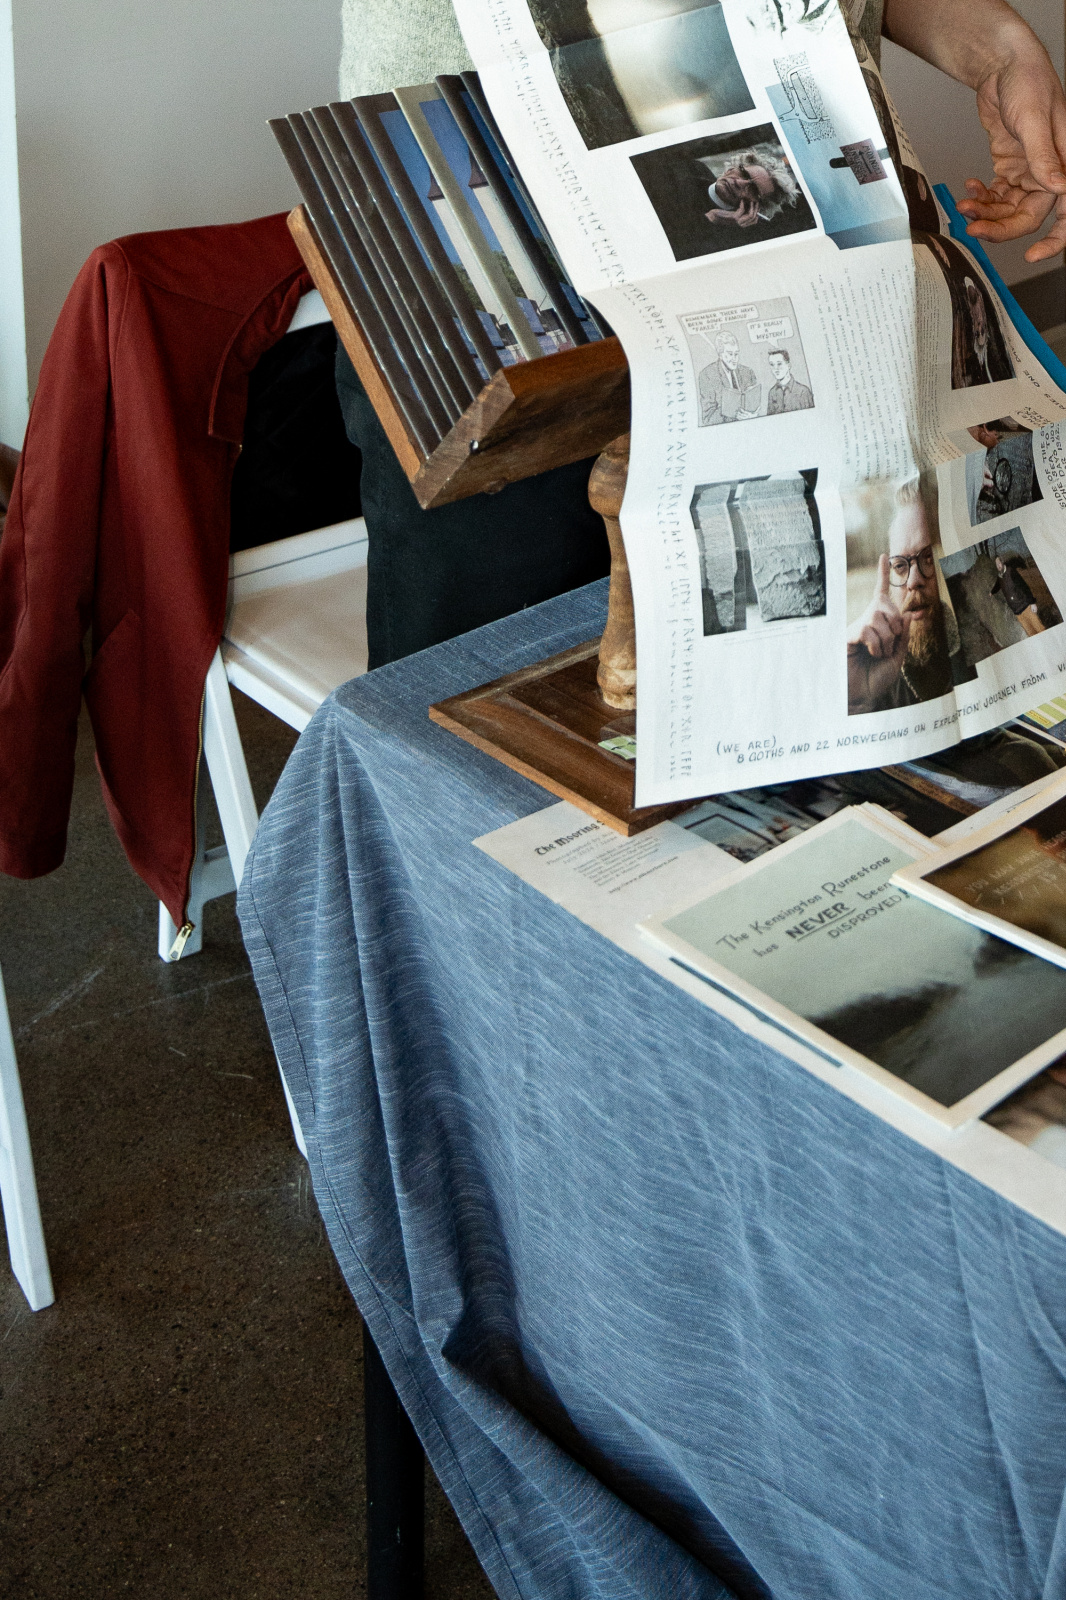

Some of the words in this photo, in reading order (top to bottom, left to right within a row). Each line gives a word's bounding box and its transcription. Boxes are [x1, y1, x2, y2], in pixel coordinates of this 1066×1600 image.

[720, 310, 737, 318] THERE
[724, 313, 747, 322] FAMOUS
[756, 329, 786, 340] MYSTERY!
[1022, 369, 1040, 388] ONE
[1044, 469, 1053, 481] OF
[1052, 486, 1066, 508] SIDE
[737, 754, 744, 763] 8
[749, 747, 785, 762] GOTHS
[790, 743, 810, 754] AND
[816, 740, 830, 750] 22
[836, 728, 909, 747] NORWEGIANS
[914, 723, 926, 733] ON
[983, 684, 1017, 708] JOURNEY
[716, 741, 740, 755] (WE
[747, 735, 777, 749] ARE)
[534, 843, 555, 856] The
[554, 822, 600, 847] Mooring
[716, 932, 750, 950] The
[749, 895, 822, 935] Kensington
[821, 856, 891, 897] Runestone
[752, 942, 780, 958] has
[785, 901, 850, 940] NEVER
[857, 882, 893, 901] been
